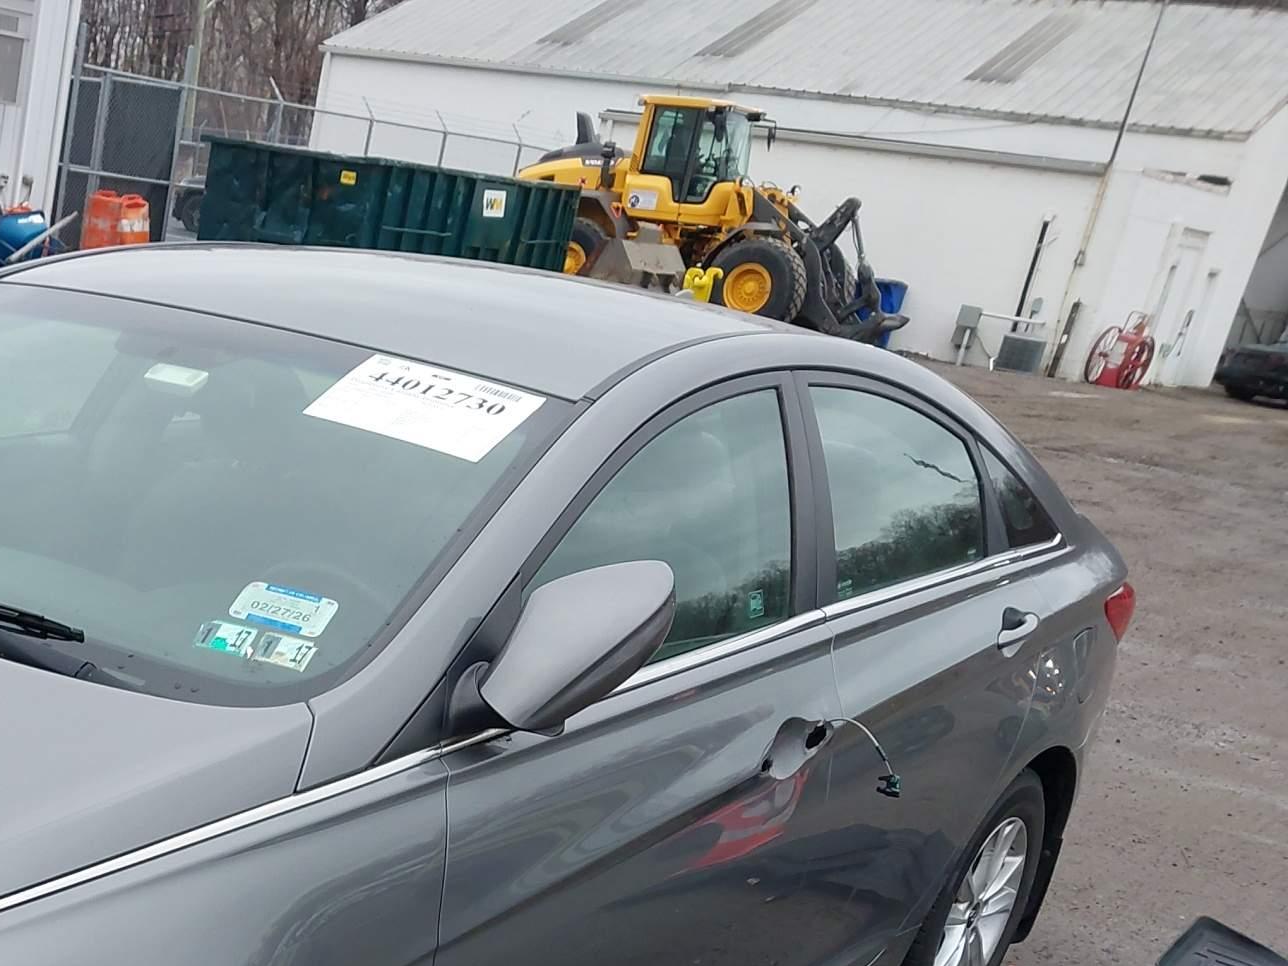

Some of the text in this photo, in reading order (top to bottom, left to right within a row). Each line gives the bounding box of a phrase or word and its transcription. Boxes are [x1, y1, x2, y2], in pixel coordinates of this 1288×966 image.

[368, 372, 506, 416] 44012730
[250, 600, 312, 623] 02/27/26
[229, 629, 252, 648] 17
[289, 643, 312, 664] 17
